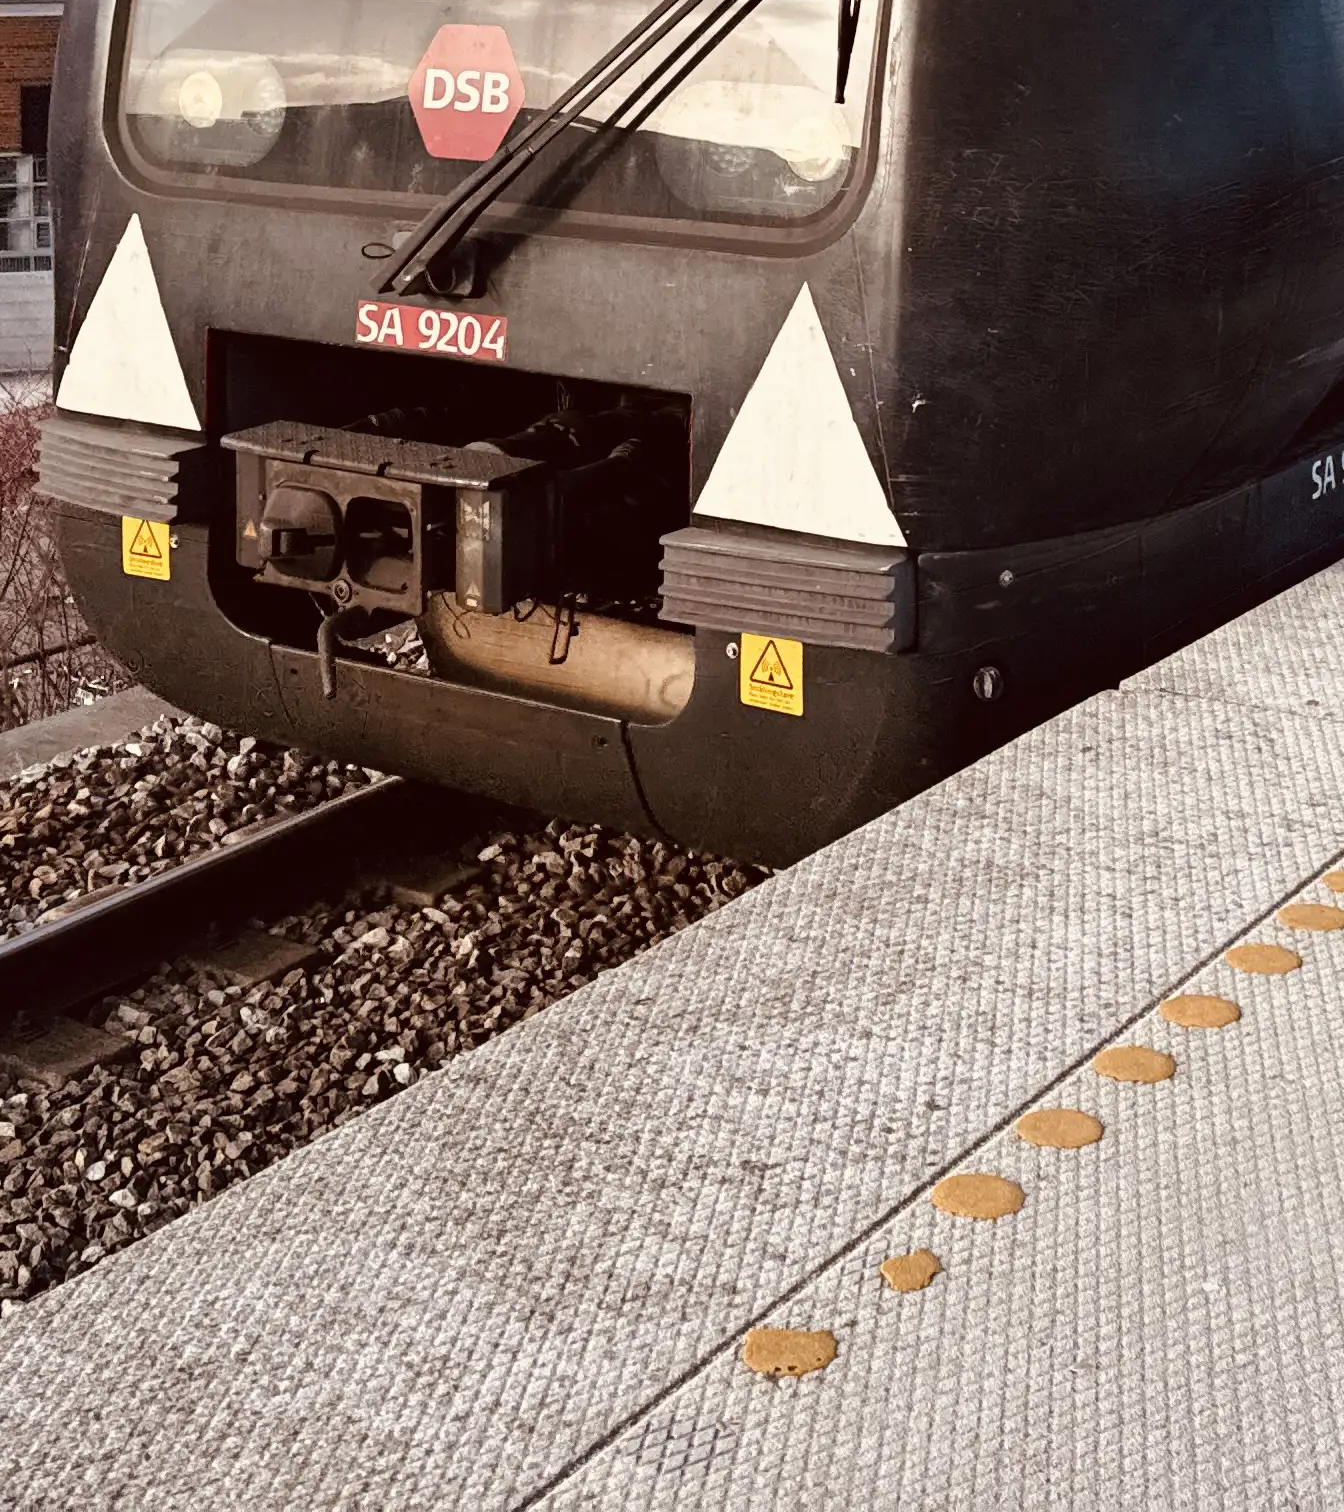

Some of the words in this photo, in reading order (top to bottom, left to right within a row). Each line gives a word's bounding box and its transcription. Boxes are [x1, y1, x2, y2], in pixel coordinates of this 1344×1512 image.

[423, 68, 511, 114] DSB
[356, 303, 404, 346] SA
[417, 310, 506, 359] 9204
[1311, 455, 1336, 500] SA
